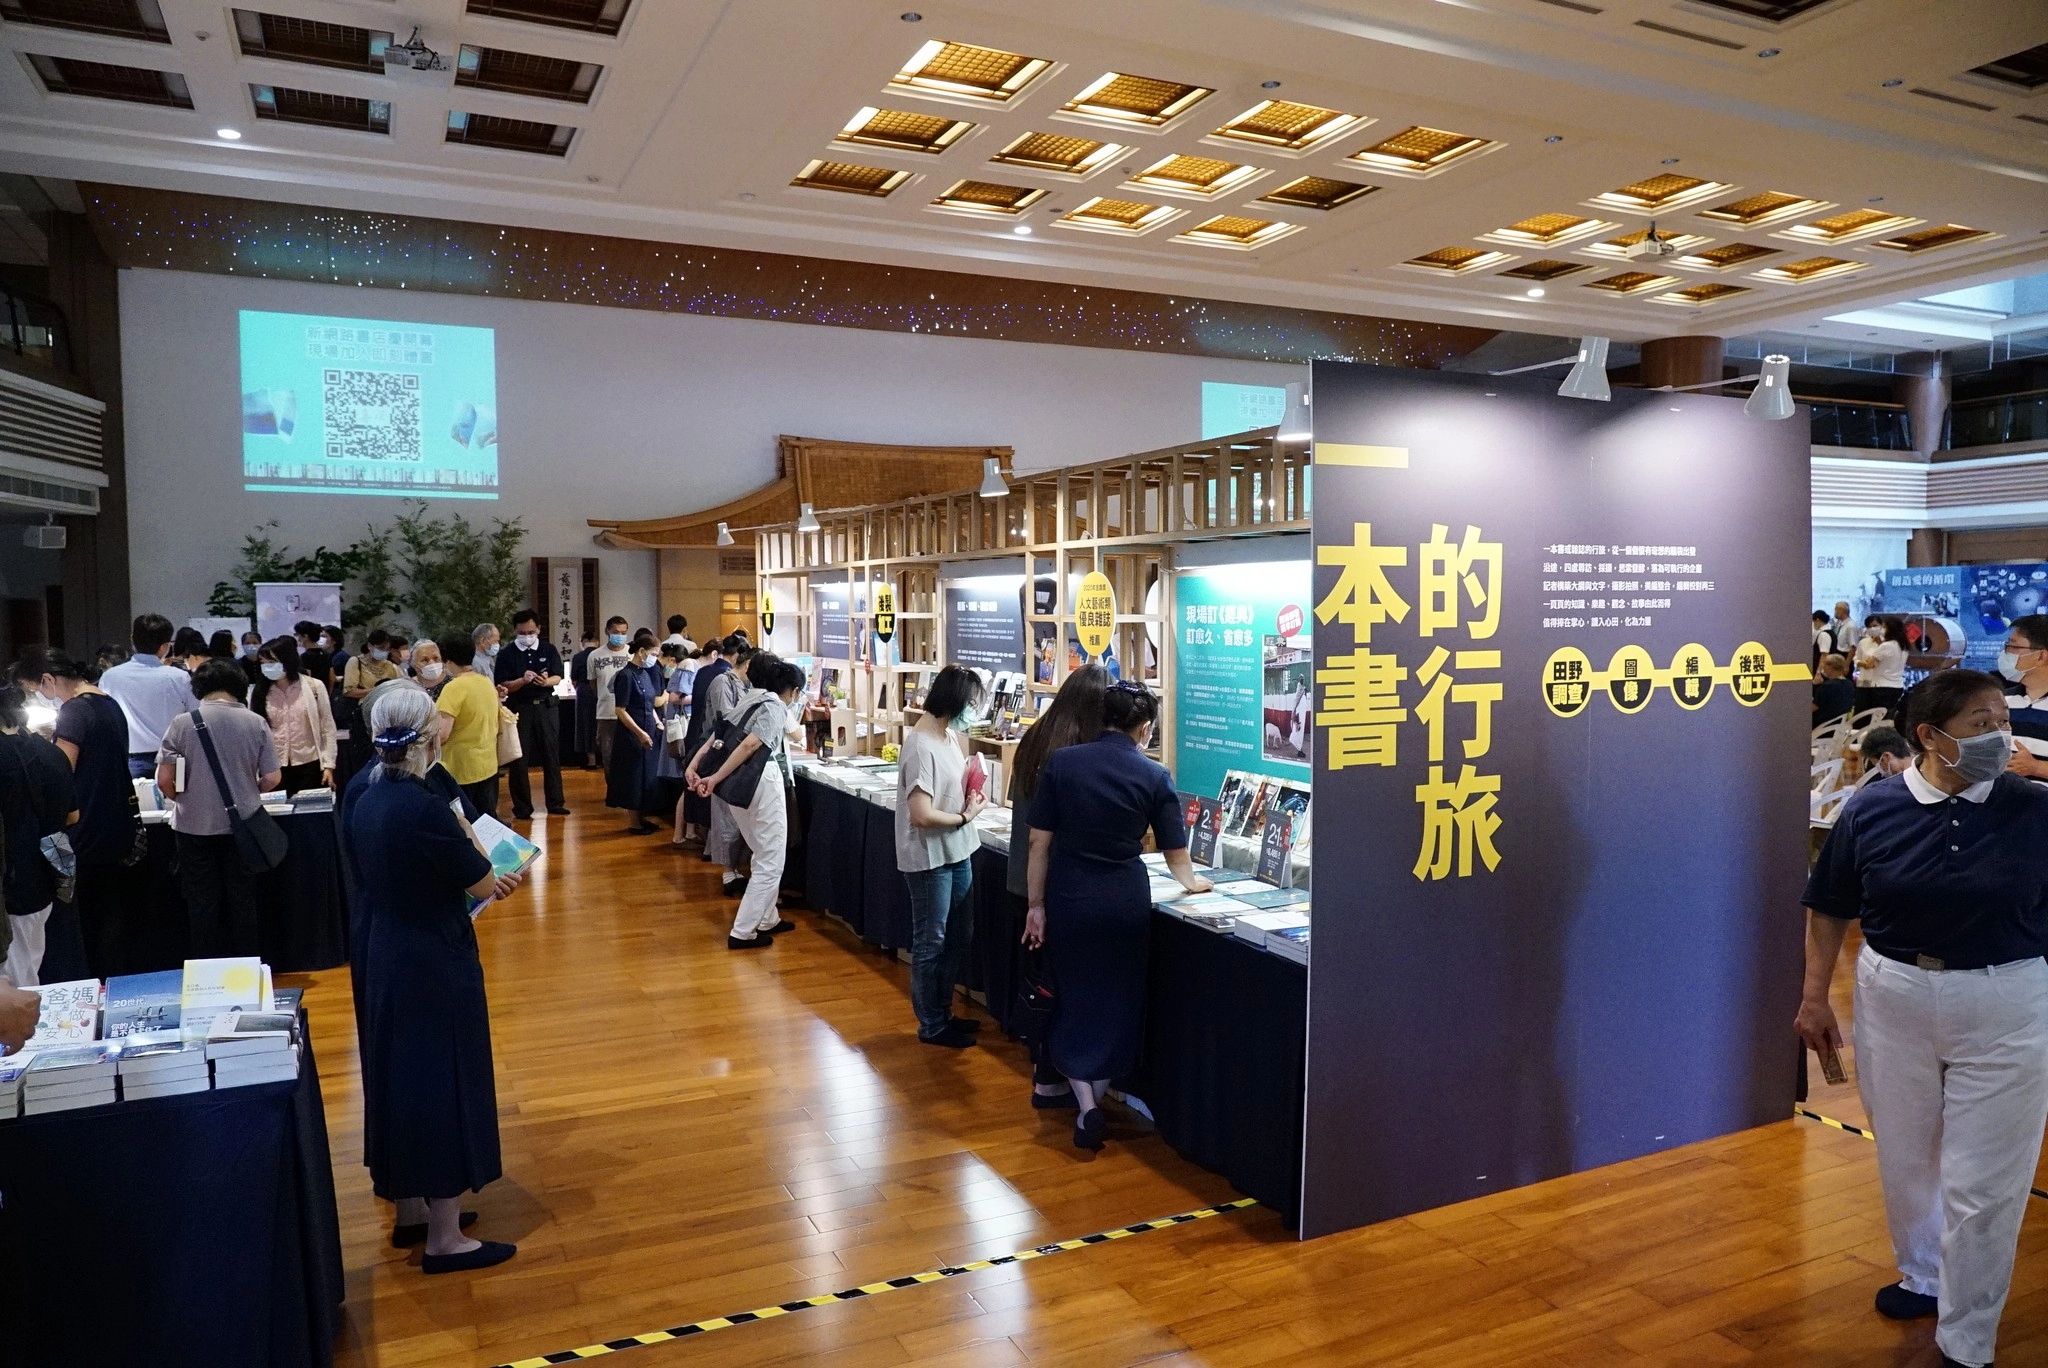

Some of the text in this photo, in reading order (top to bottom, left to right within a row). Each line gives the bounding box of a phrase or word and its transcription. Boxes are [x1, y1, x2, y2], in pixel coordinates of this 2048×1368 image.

[1079, 597, 1111, 610] 人文藝術類
[1313, 442, 1411, 771] 一本書
[1079, 611, 1111, 628] 優良雜誌
[1186, 627, 1254, 647] 訂愈久、省愈多
[1553, 660, 1583, 681] 田野
[1624, 658, 1638, 678] 圖
[1685, 656, 1699, 675] 編
[1739, 654, 1766, 673] 後製
[1552, 683, 1584, 706] 調查
[1623, 680, 1639, 702] 像
[1684, 677, 1700, 699] 輯
[1739, 675, 1766, 696] 加工
[1412, 523, 1504, 883] 的行旅
[110, 1020, 146, 1031] 你的人生
